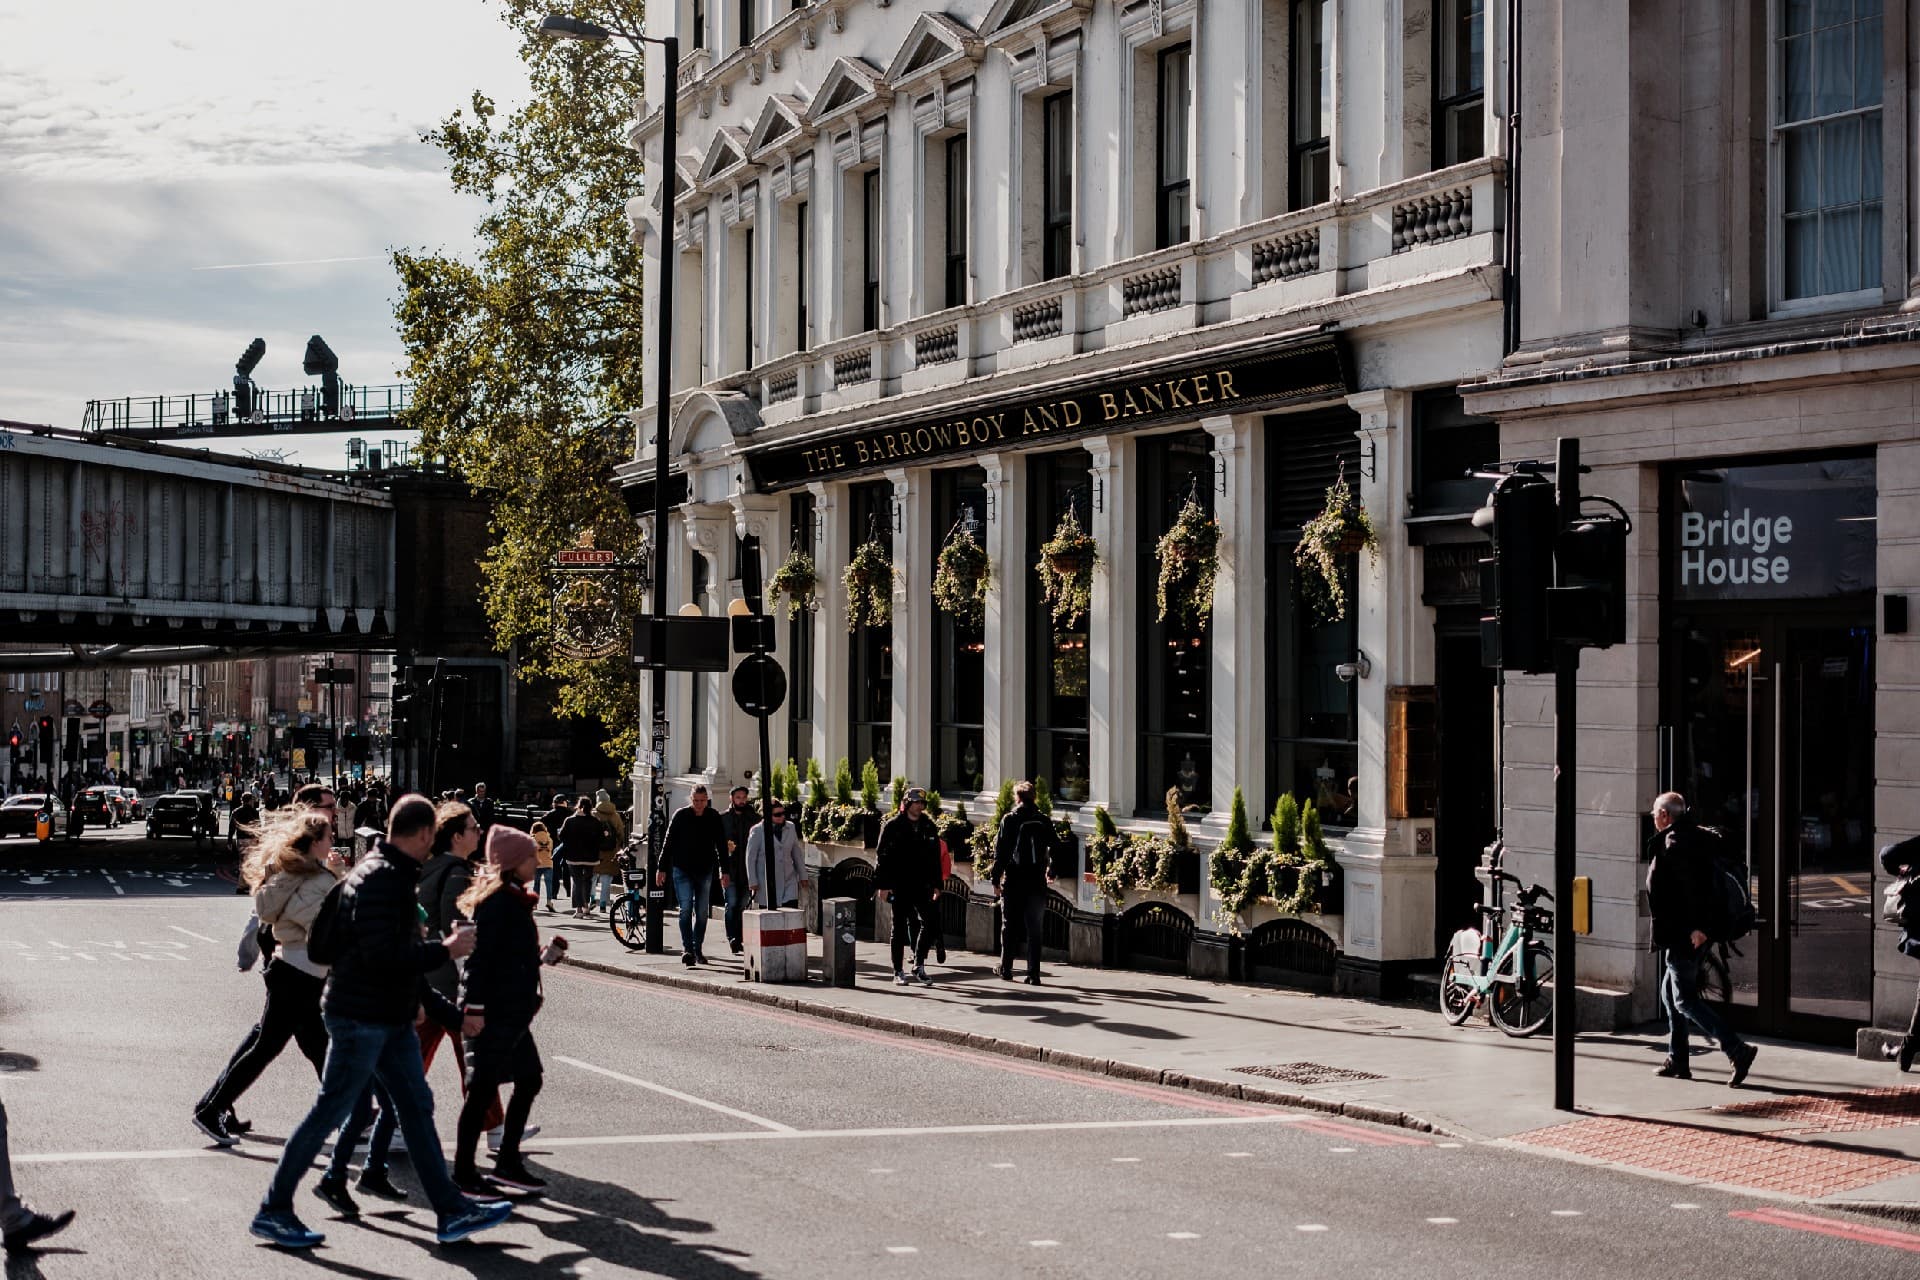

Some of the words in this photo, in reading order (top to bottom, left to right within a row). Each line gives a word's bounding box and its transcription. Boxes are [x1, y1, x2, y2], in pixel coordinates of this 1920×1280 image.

[802, 445, 846, 473] THE
[854, 413, 1005, 463] BARROWBOY
[1022, 400, 1083, 435] AND
[1099, 370, 1240, 421] BANKER
[1682, 507, 1793, 553] Bridge
[1682, 549, 1790, 585] House
